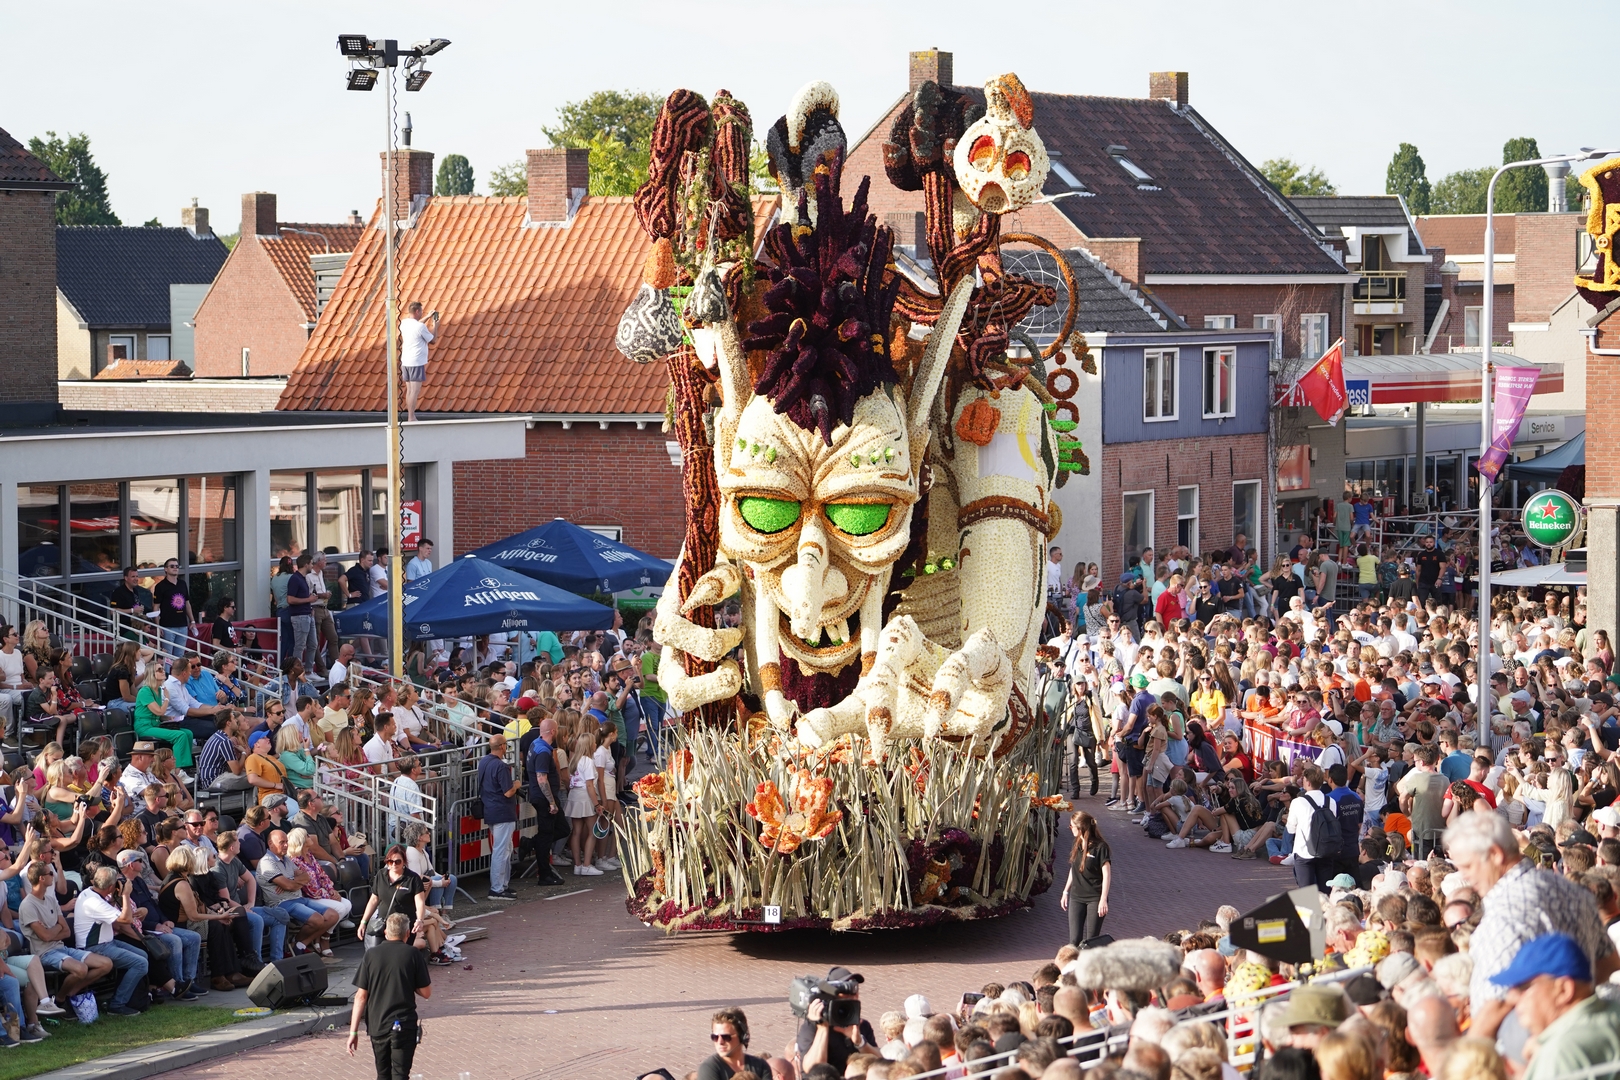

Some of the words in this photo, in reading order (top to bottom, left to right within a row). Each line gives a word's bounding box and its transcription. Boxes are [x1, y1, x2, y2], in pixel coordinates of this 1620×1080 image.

[1531, 422, 1555, 434] Service
[1529, 520, 1571, 530] Heineken
[490, 548, 558, 563] Affligem
[463, 588, 541, 607] Affligem
[767, 908, 778, 917] 18
